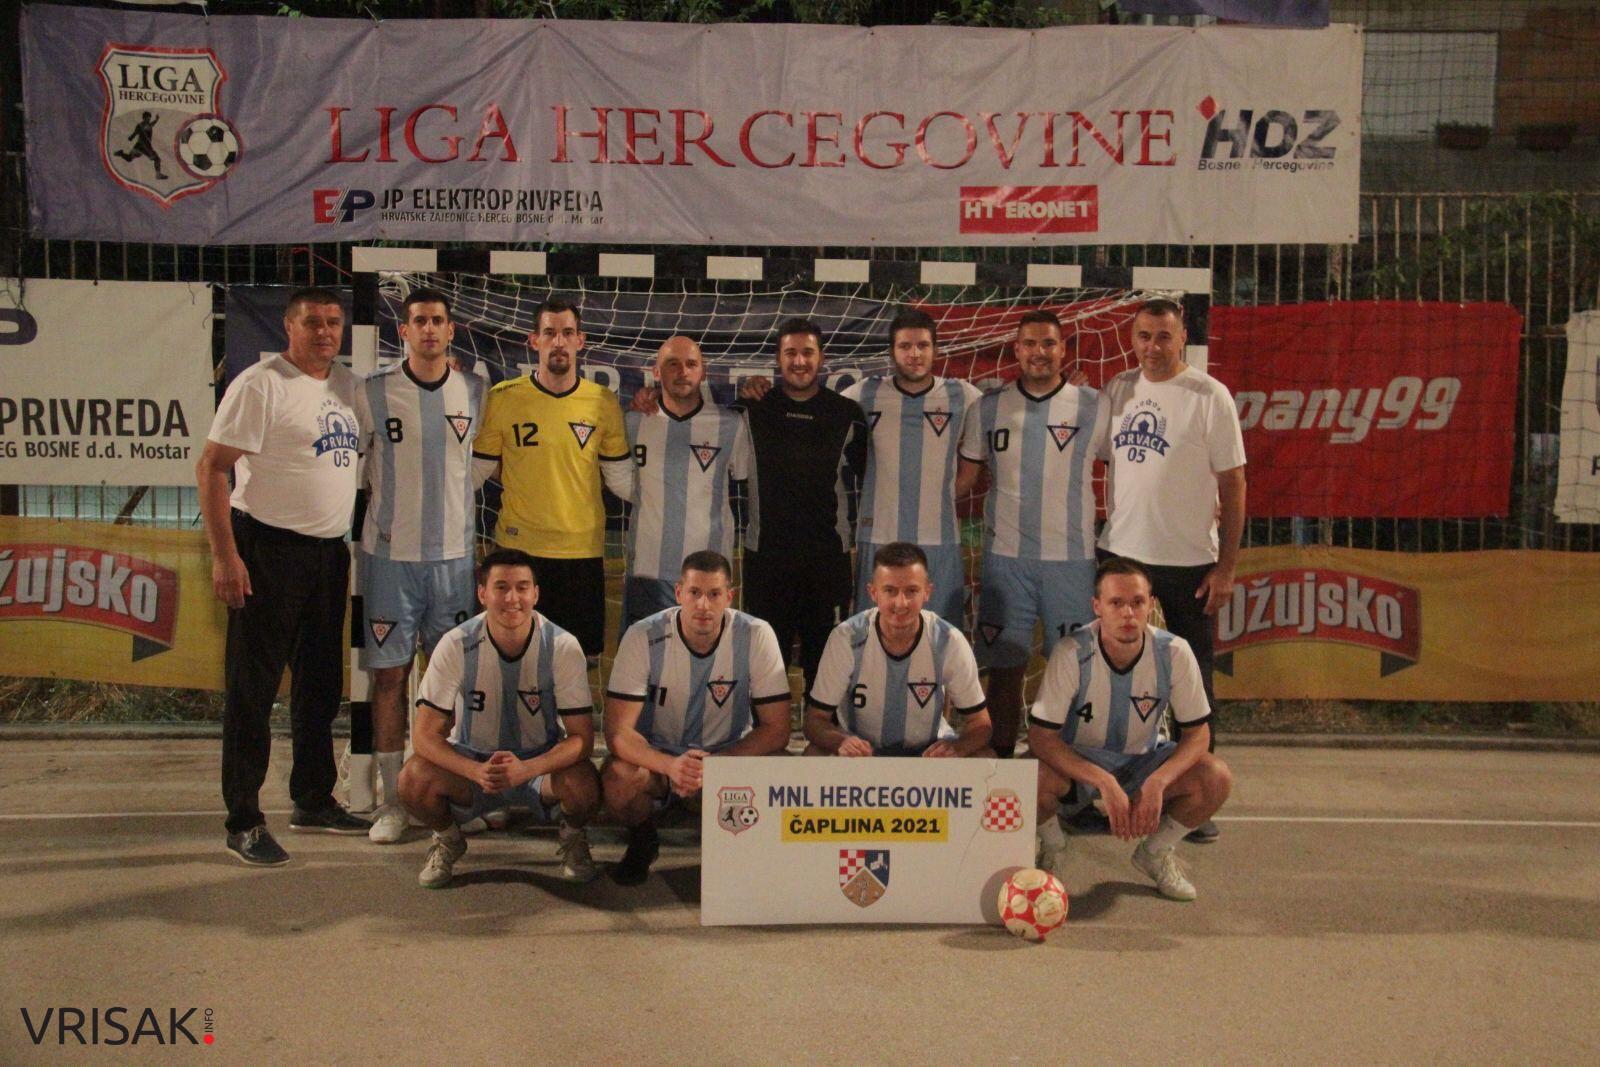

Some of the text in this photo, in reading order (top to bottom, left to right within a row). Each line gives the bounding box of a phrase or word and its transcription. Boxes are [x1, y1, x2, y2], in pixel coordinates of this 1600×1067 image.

[117, 64, 205, 92] LIGA
[119, 91, 206, 105] HERCEGOVINE
[325, 102, 1177, 169] LIGA HERCEGOVINE
[1198, 160, 1241, 171] Bosne
[381, 188, 603, 211] JP ELEKTROPRIVREDA
[964, 200, 1088, 219] HT ERONET
[381, 212, 426, 222] HRVATSKE
[516, 213, 545, 224] BOSNE
[0, 397, 190, 437] PRIVREDA
[868, 411, 882, 431] 7
[385, 417, 403, 443] 8
[512, 422, 539, 447] 12
[987, 428, 1010, 452] 10
[25, 441, 80, 458] BOSNE
[86, 442, 122, 459] d.d.
[130, 442, 191, 460] Mostar
[321, 434, 359, 451] PRVACI
[1118, 433, 1164, 451] PRVACI
[333, 450, 350, 468] 05
[634, 444, 647, 467] 9
[1127, 447, 1147, 463] 05
[467, 690, 486, 712] 3
[852, 683, 868, 709] 6
[1075, 701, 1093, 723] 4
[724, 792, 748, 801] LIGA
[768, 786, 973, 809] MNL HERCEGOVINE
[789, 814, 941, 834] ČAPLJINA 2021
